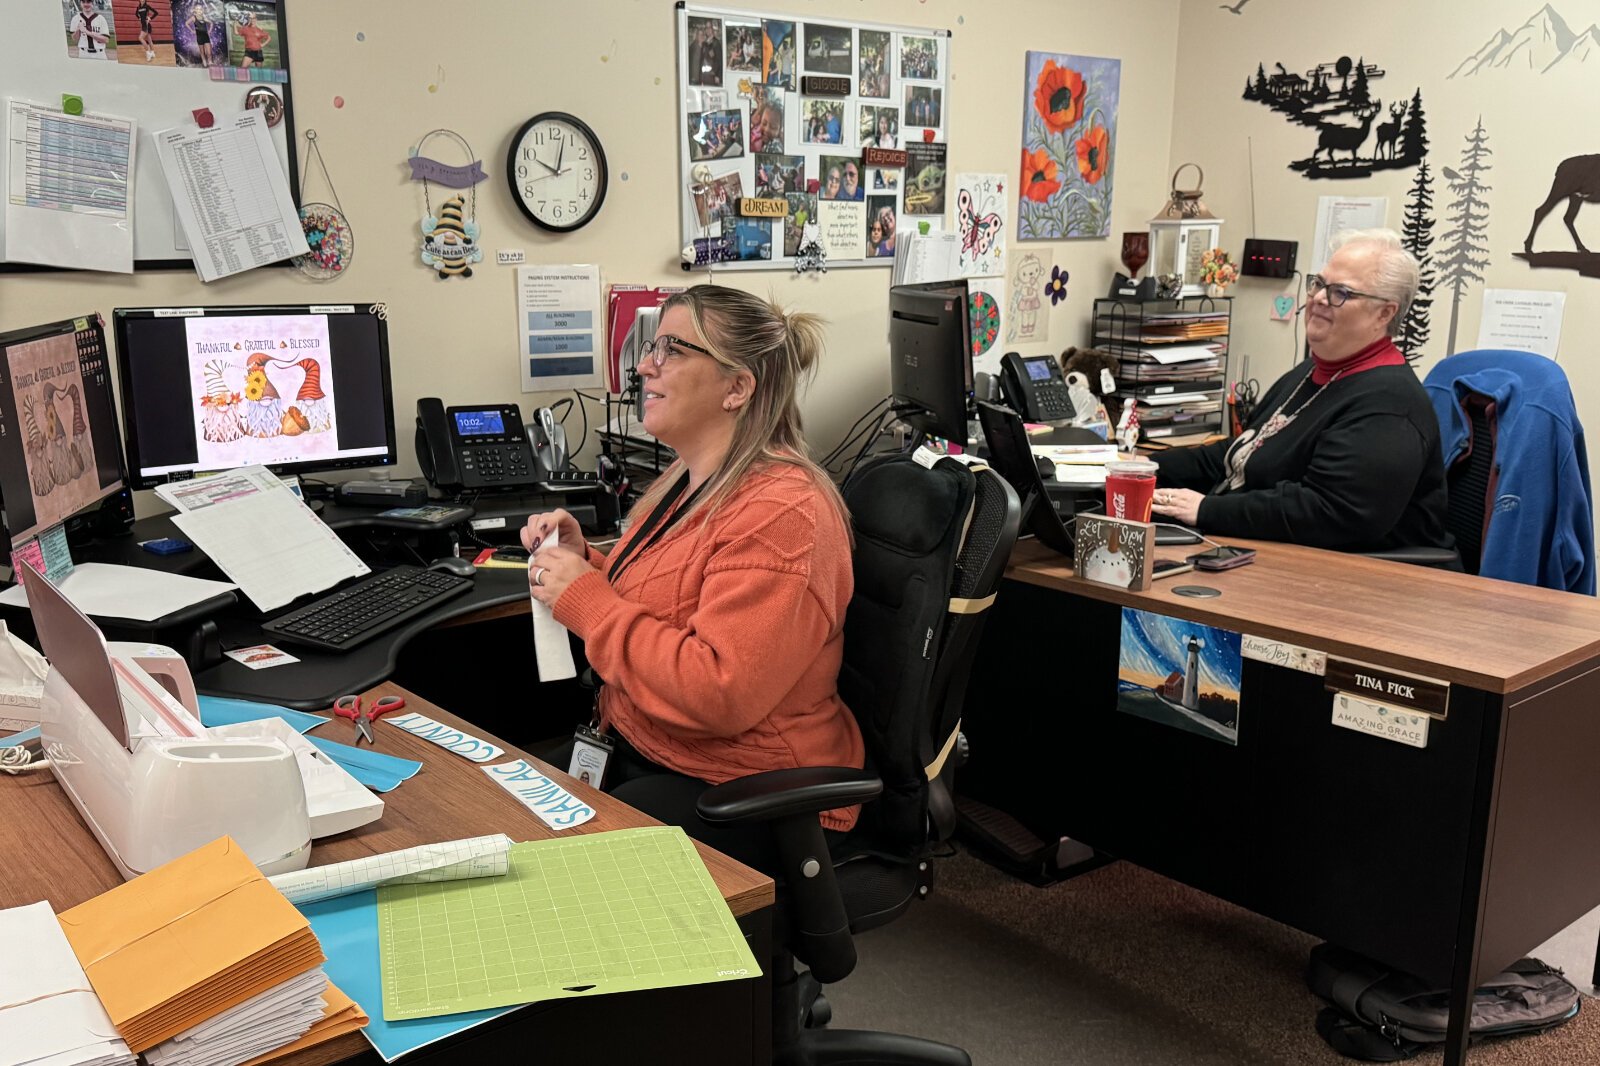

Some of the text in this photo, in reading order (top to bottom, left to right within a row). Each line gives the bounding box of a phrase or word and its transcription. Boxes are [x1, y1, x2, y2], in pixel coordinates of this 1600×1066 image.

[535, 132, 544, 145] 11
[549, 127, 561, 141] 12
[569, 134, 574, 147] 1
[523, 148, 537, 161] 10
[578, 148, 587, 160] 2
[518, 165, 528, 178] 9
[584, 168, 593, 181] 3
[524, 186, 534, 199] 8
[579, 188, 588, 200] 4
[537, 201, 547, 213] 7
[552, 205, 562, 218] 6
[568, 201, 578, 213] 5
[744, 198, 784, 215] DREAM
[424, 243, 441, 255] Cute
[195, 338, 320, 354] THANKFUL GRATEFUL BLESSED
[459, 418, 480, 427] 10:02
[1079, 520, 1105, 540] Let
[1354, 673, 1415, 699] TINA FICK
[1337, 713, 1421, 740] AMAZING GRACE
[395, 716, 494, 760] COUNTY
[492, 761, 591, 825] SANILAC
[716, 968, 749, 977] Cricut
